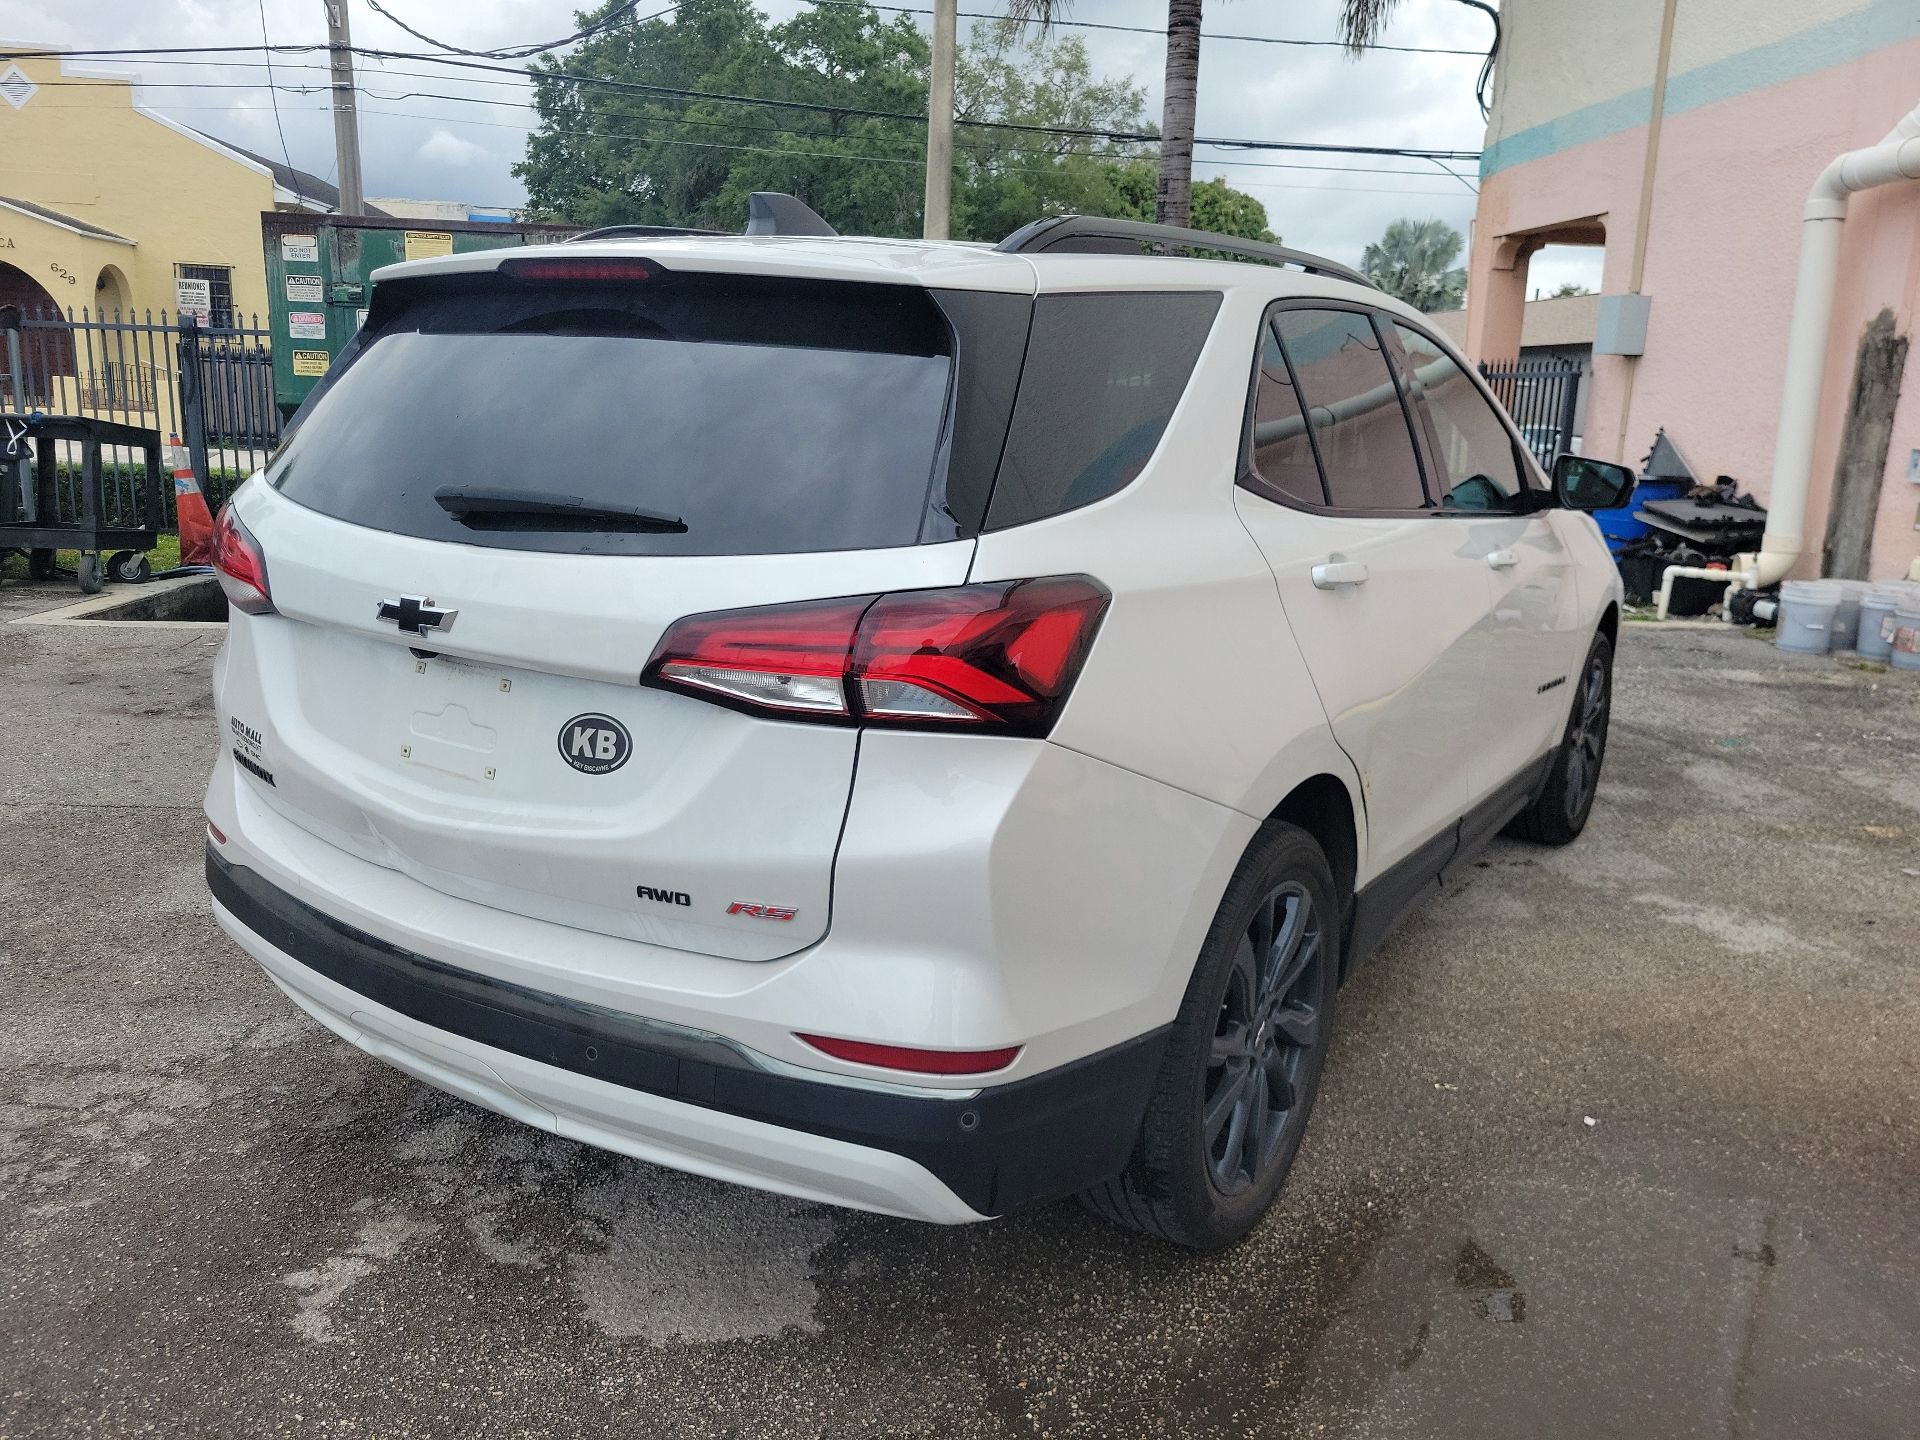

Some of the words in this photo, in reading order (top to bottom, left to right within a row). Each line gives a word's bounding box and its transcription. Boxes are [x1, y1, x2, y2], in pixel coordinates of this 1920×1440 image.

[50, 262, 76, 285] 629
[295, 277, 320, 285] CAUTION
[178, 281, 206, 291] REUNIONES
[299, 314, 323, 323] DANGER
[302, 352, 328, 360] CAUTION
[245, 725, 262, 745] MALL
[571, 726, 617, 760] KB
[573, 760, 584, 769] KEY
[583, 764, 610, 773] BISCAYNE
[636, 885, 691, 906] AWD
[726, 901, 799, 921] RS
